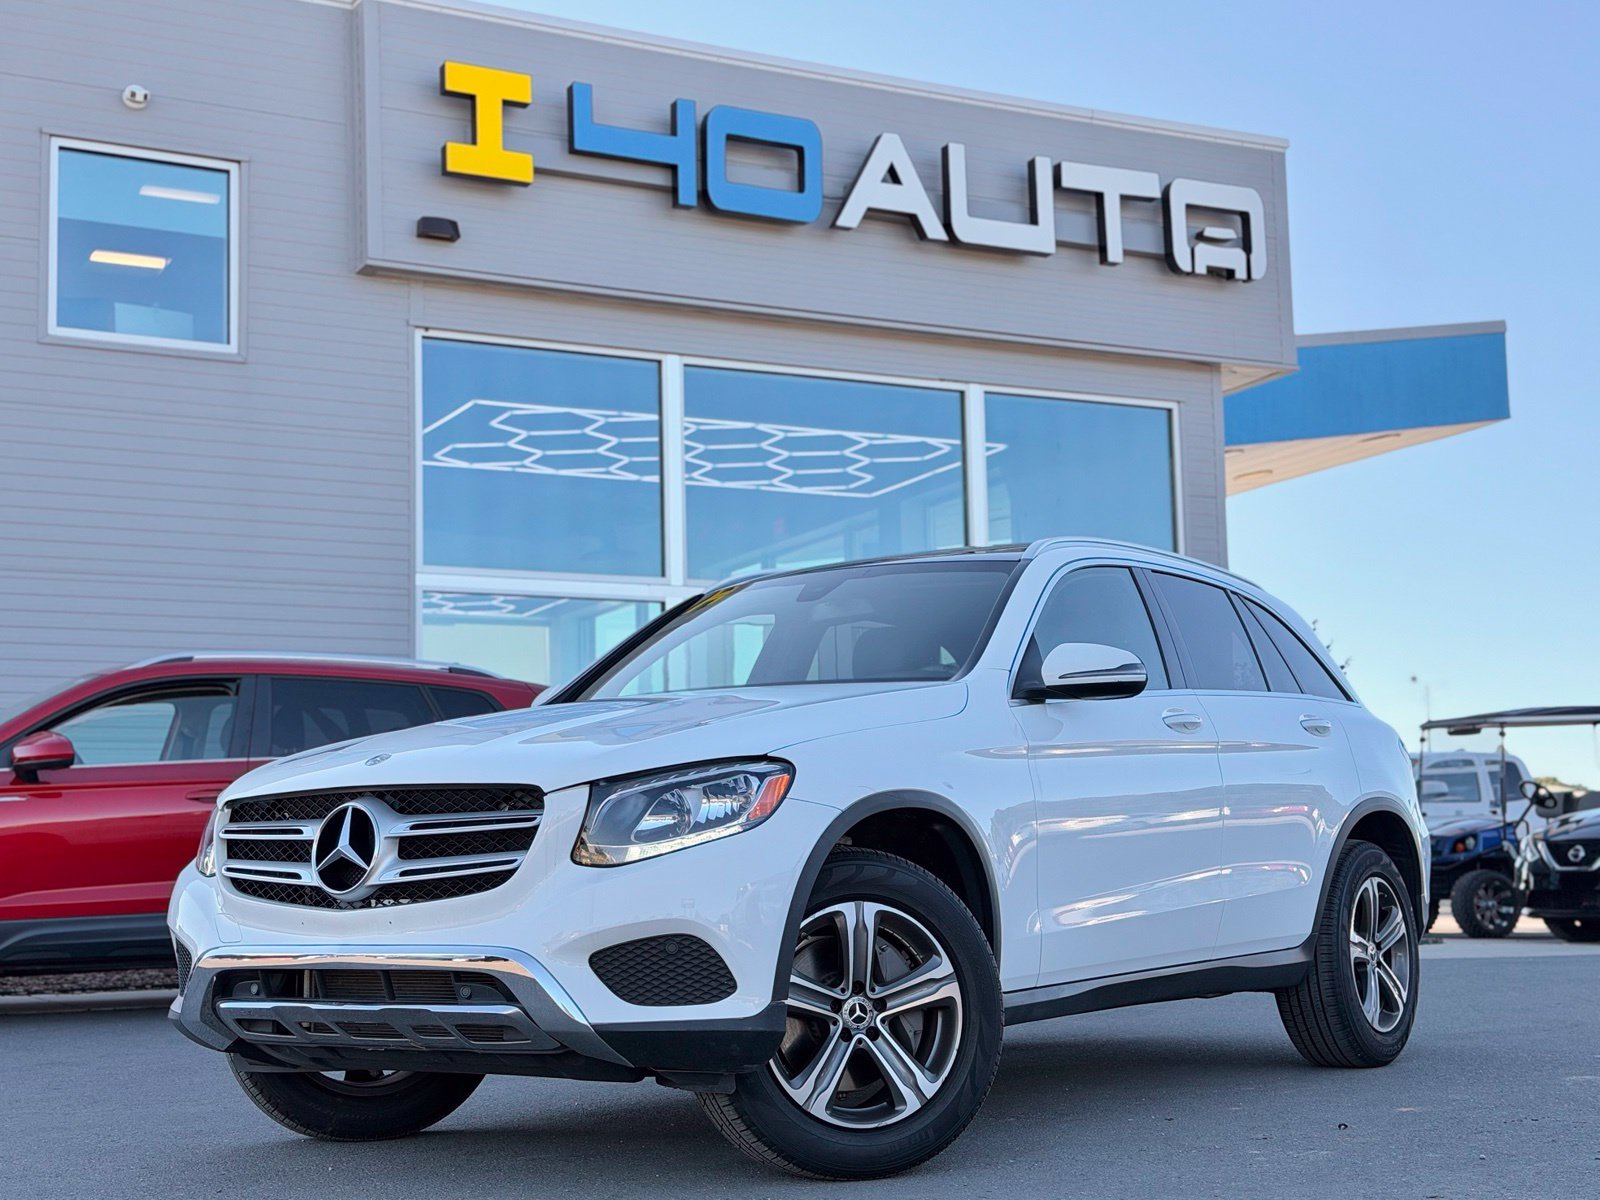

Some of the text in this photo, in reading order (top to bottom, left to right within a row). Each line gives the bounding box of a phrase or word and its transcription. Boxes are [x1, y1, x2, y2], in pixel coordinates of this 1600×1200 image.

[440, 60, 1267, 282] I 40 AUTO
